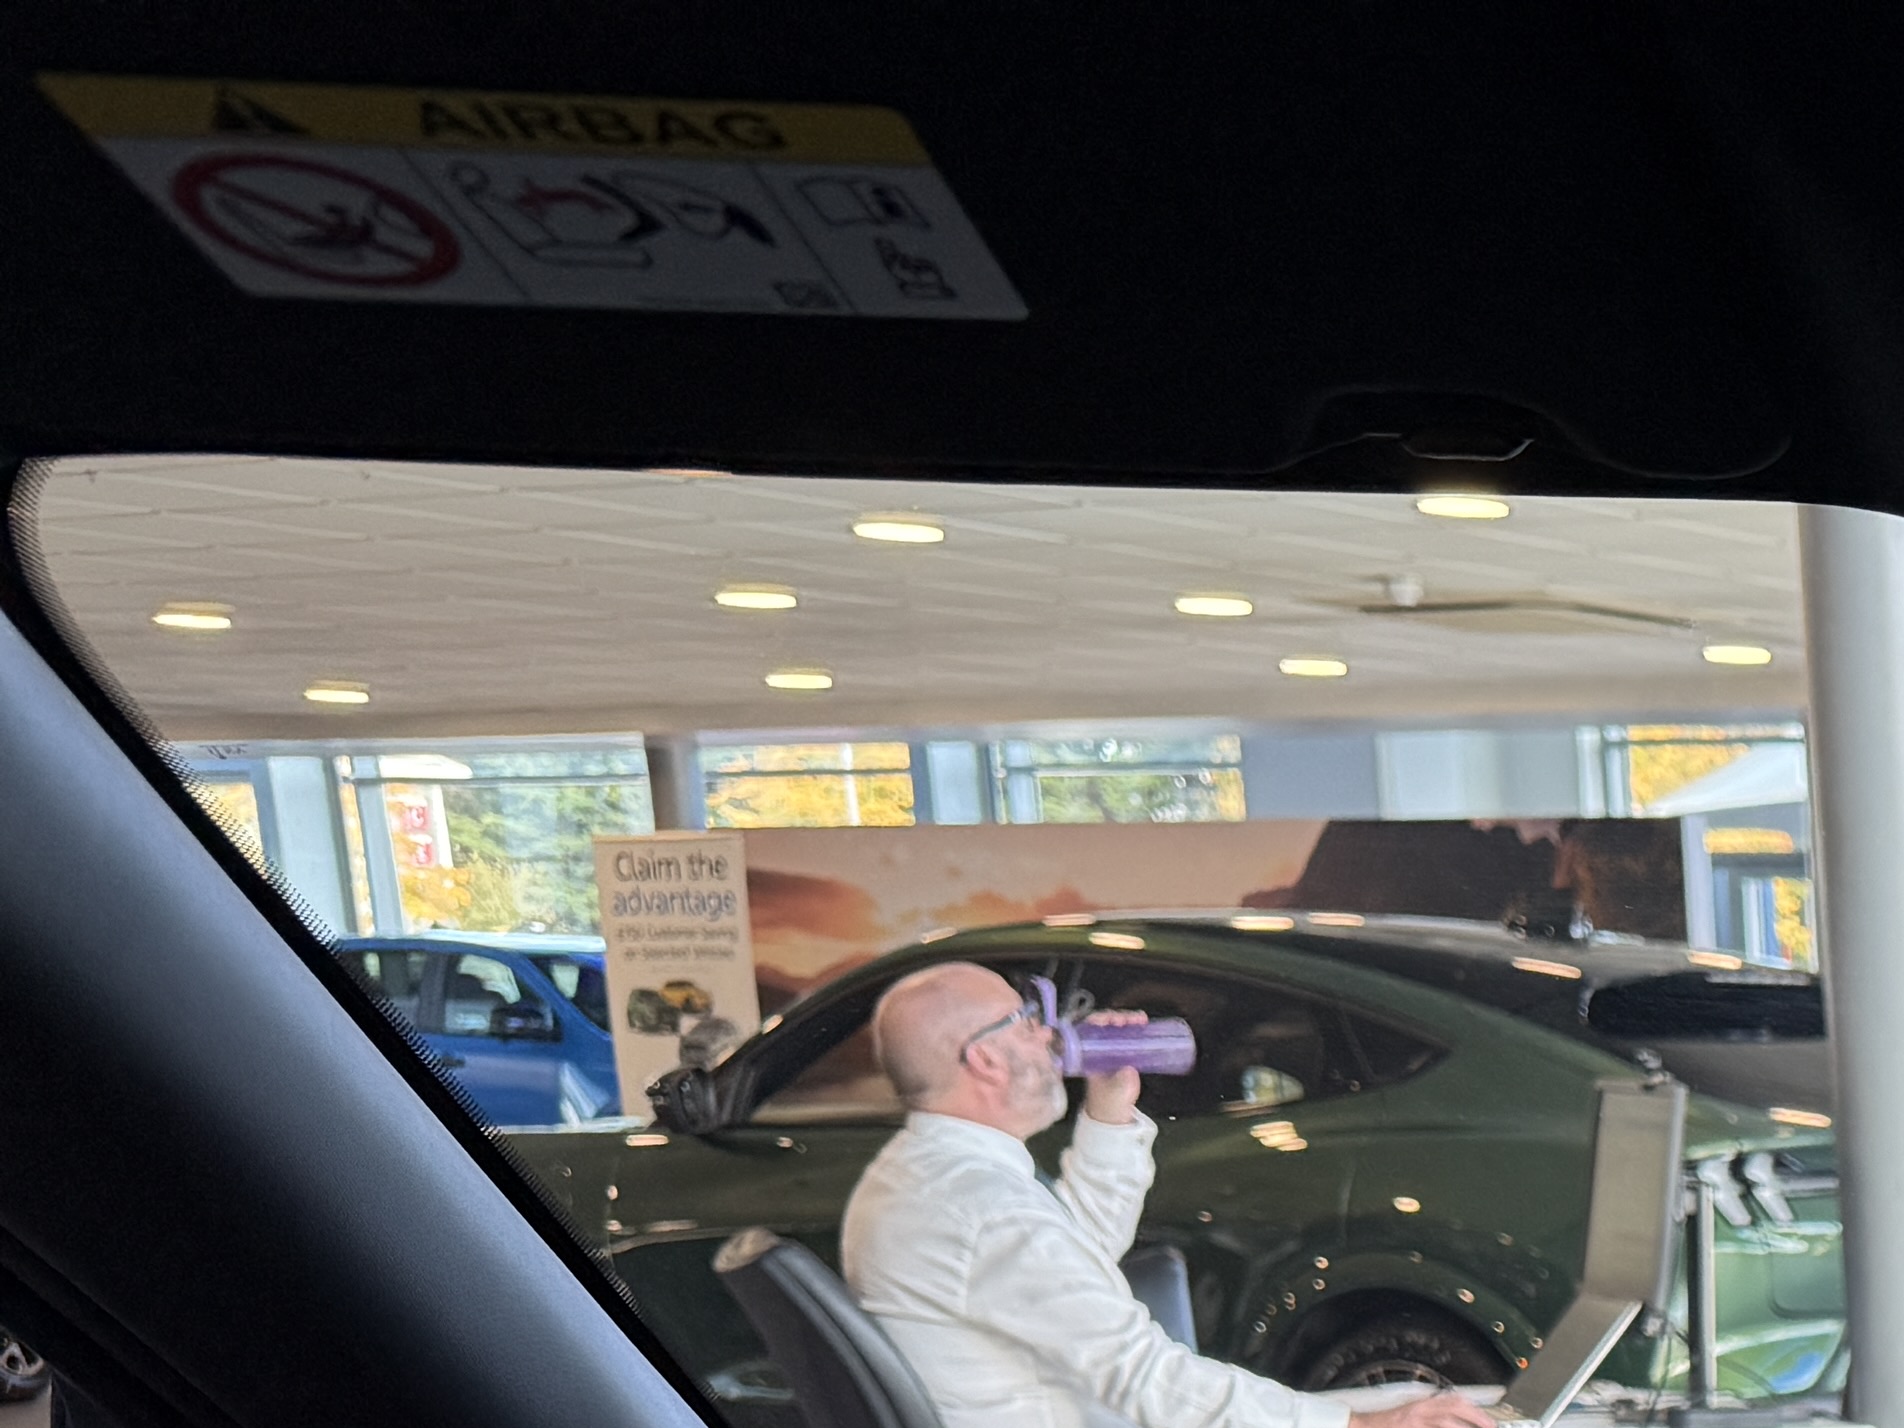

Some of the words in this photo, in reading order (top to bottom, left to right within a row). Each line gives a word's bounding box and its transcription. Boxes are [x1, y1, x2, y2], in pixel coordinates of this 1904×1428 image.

[420, 101, 788, 149] AIRBAG
[614, 850, 682, 882] Claim
[686, 849, 729, 882] the
[611, 886, 738, 922] advantage
